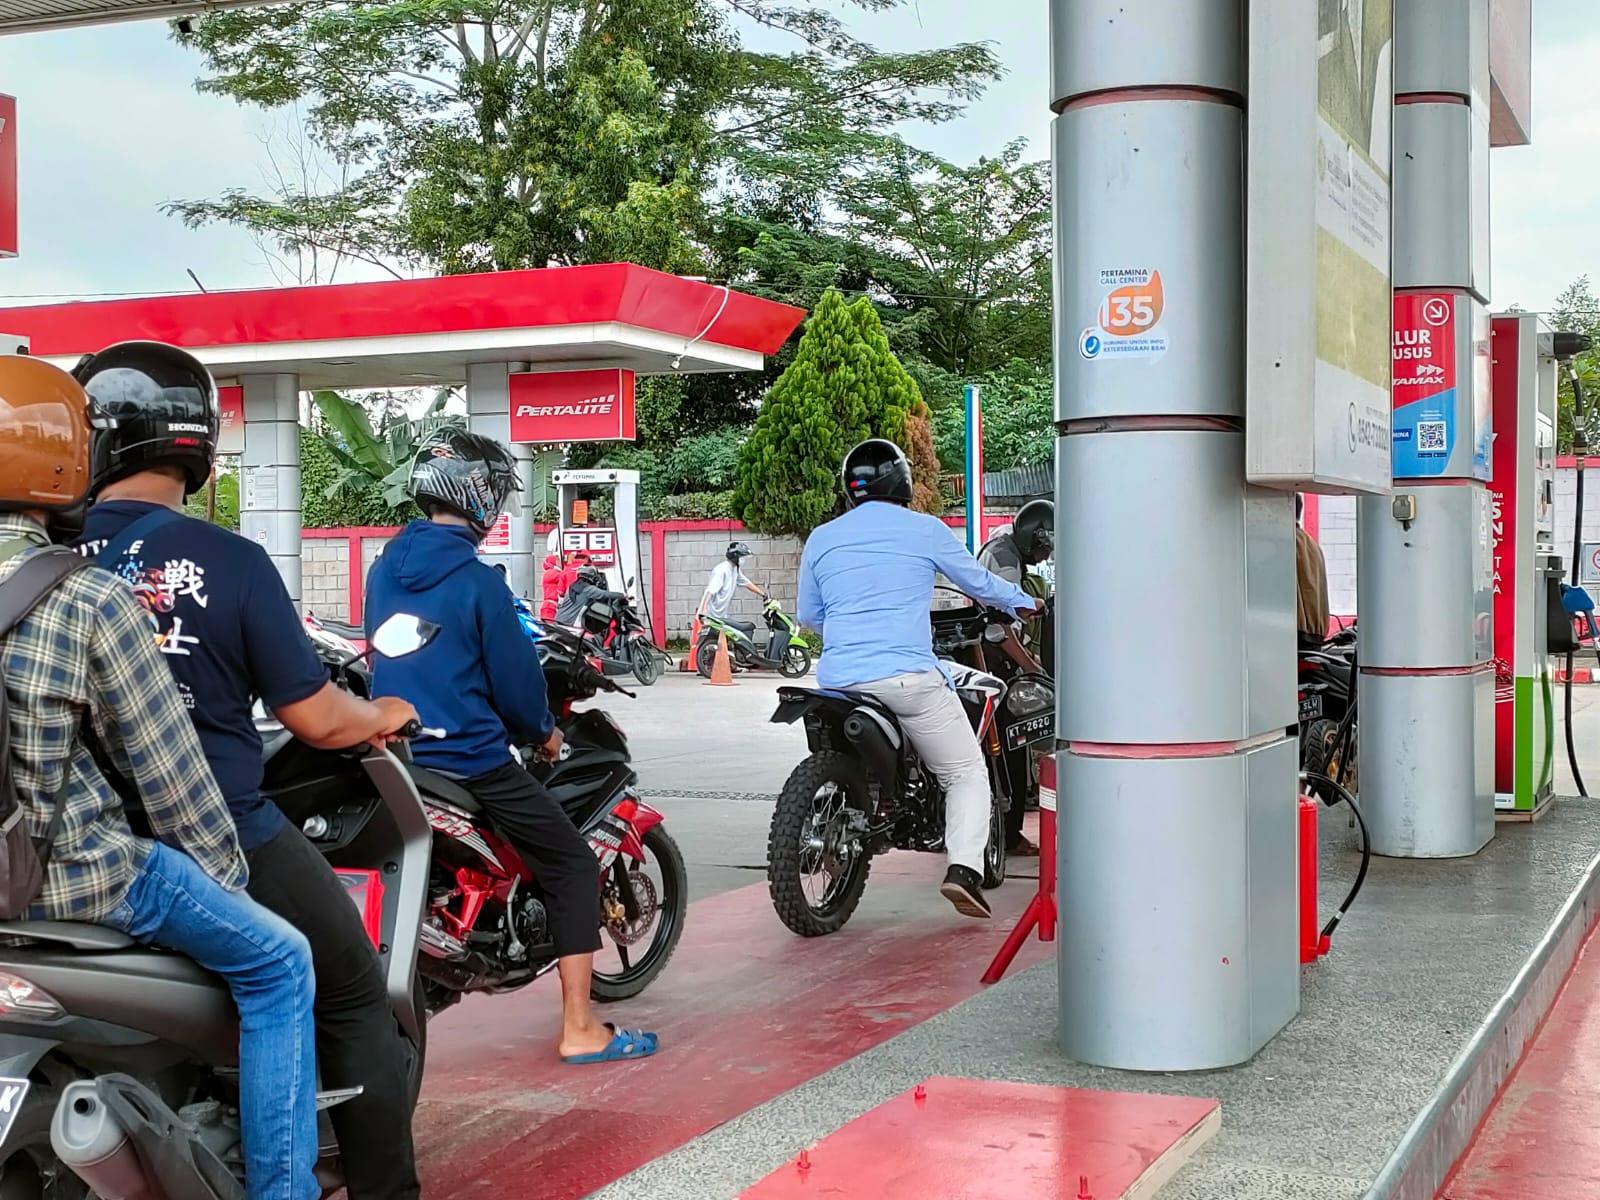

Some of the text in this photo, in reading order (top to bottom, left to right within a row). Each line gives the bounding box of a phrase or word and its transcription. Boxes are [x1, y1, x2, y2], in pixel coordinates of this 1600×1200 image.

[1101, 269, 1148, 277] PERTAMINA
[1102, 295, 1154, 328] 135
[516, 404, 612, 417] PERTALITE
[168, 423, 209, 434] HONDA
[1009, 716, 1050, 738] KT 2620
